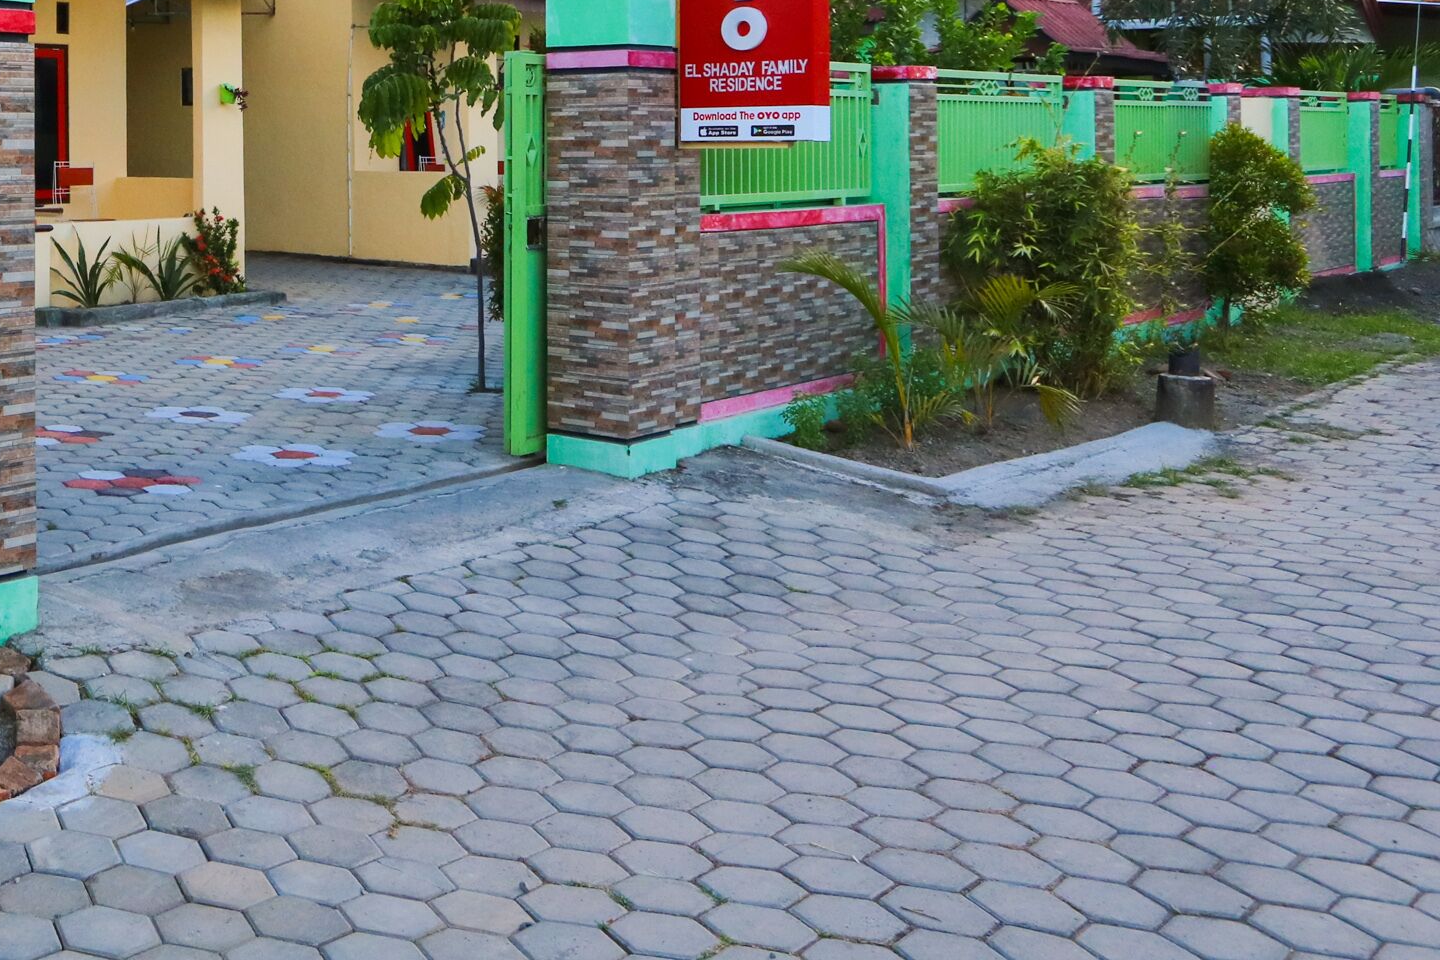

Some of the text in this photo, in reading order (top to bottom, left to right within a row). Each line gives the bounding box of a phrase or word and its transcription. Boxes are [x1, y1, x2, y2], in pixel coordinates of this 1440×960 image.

[685, 59, 808, 77] EL SHADAY FAMILY
[709, 76, 782, 92] RESIDENCE
[693, 111, 801, 121] Download The OYO app
